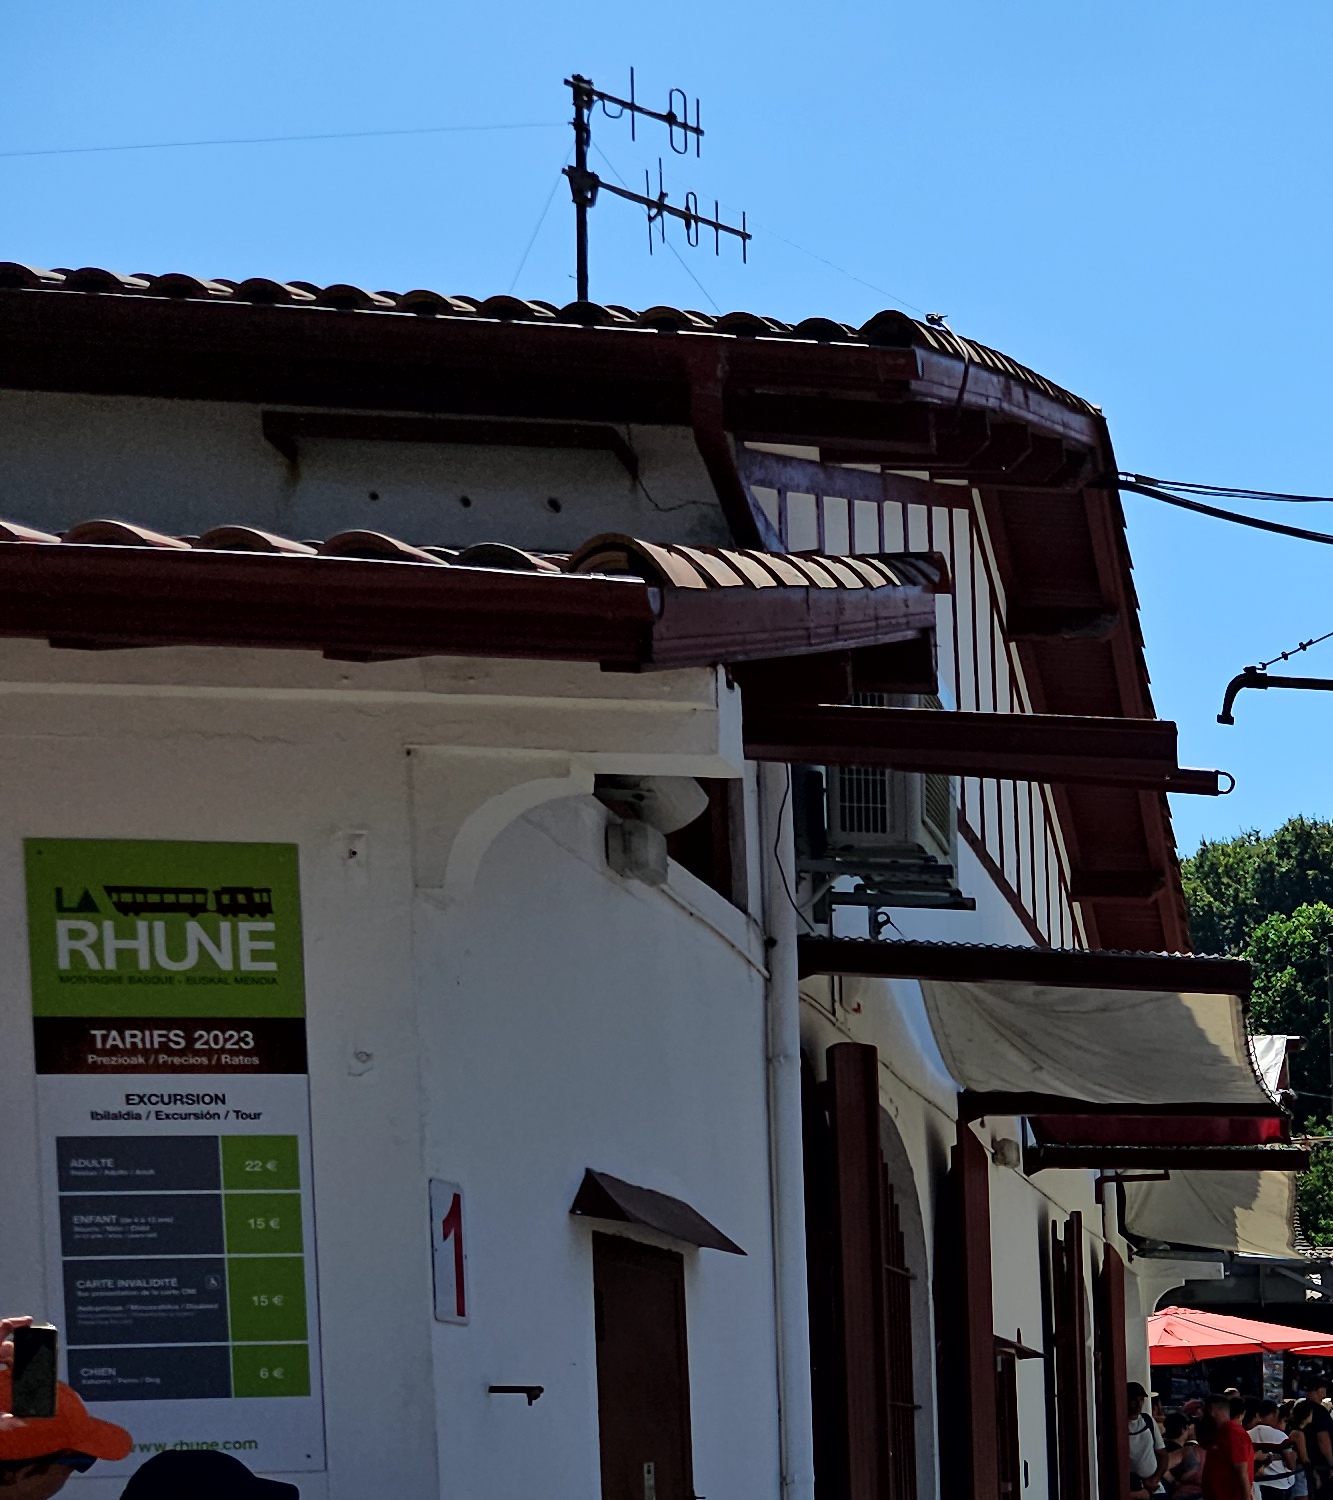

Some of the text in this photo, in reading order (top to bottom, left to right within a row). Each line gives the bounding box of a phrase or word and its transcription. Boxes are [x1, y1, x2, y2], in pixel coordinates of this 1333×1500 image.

[55, 887, 100, 913] LA
[55, 919, 278, 972] RHUNE
[91, 1030, 255, 1050] TARIFS 2023
[87, 1054, 146, 1065] Prezioak
[158, 1054, 208, 1065] Precios
[221, 1054, 260, 1065] Rates
[125, 1093, 226, 1106] EXCURSION
[155, 1110, 220, 1121] Excursión
[233, 1110, 263, 1121] Tour
[245, 1161, 277, 1171] 22 €
[249, 1218, 280, 1229] 15 €
[442, 1192, 466, 1318] 1
[252, 1295, 283, 1306] 15 €
[260, 1369, 284, 1379] 6 €
